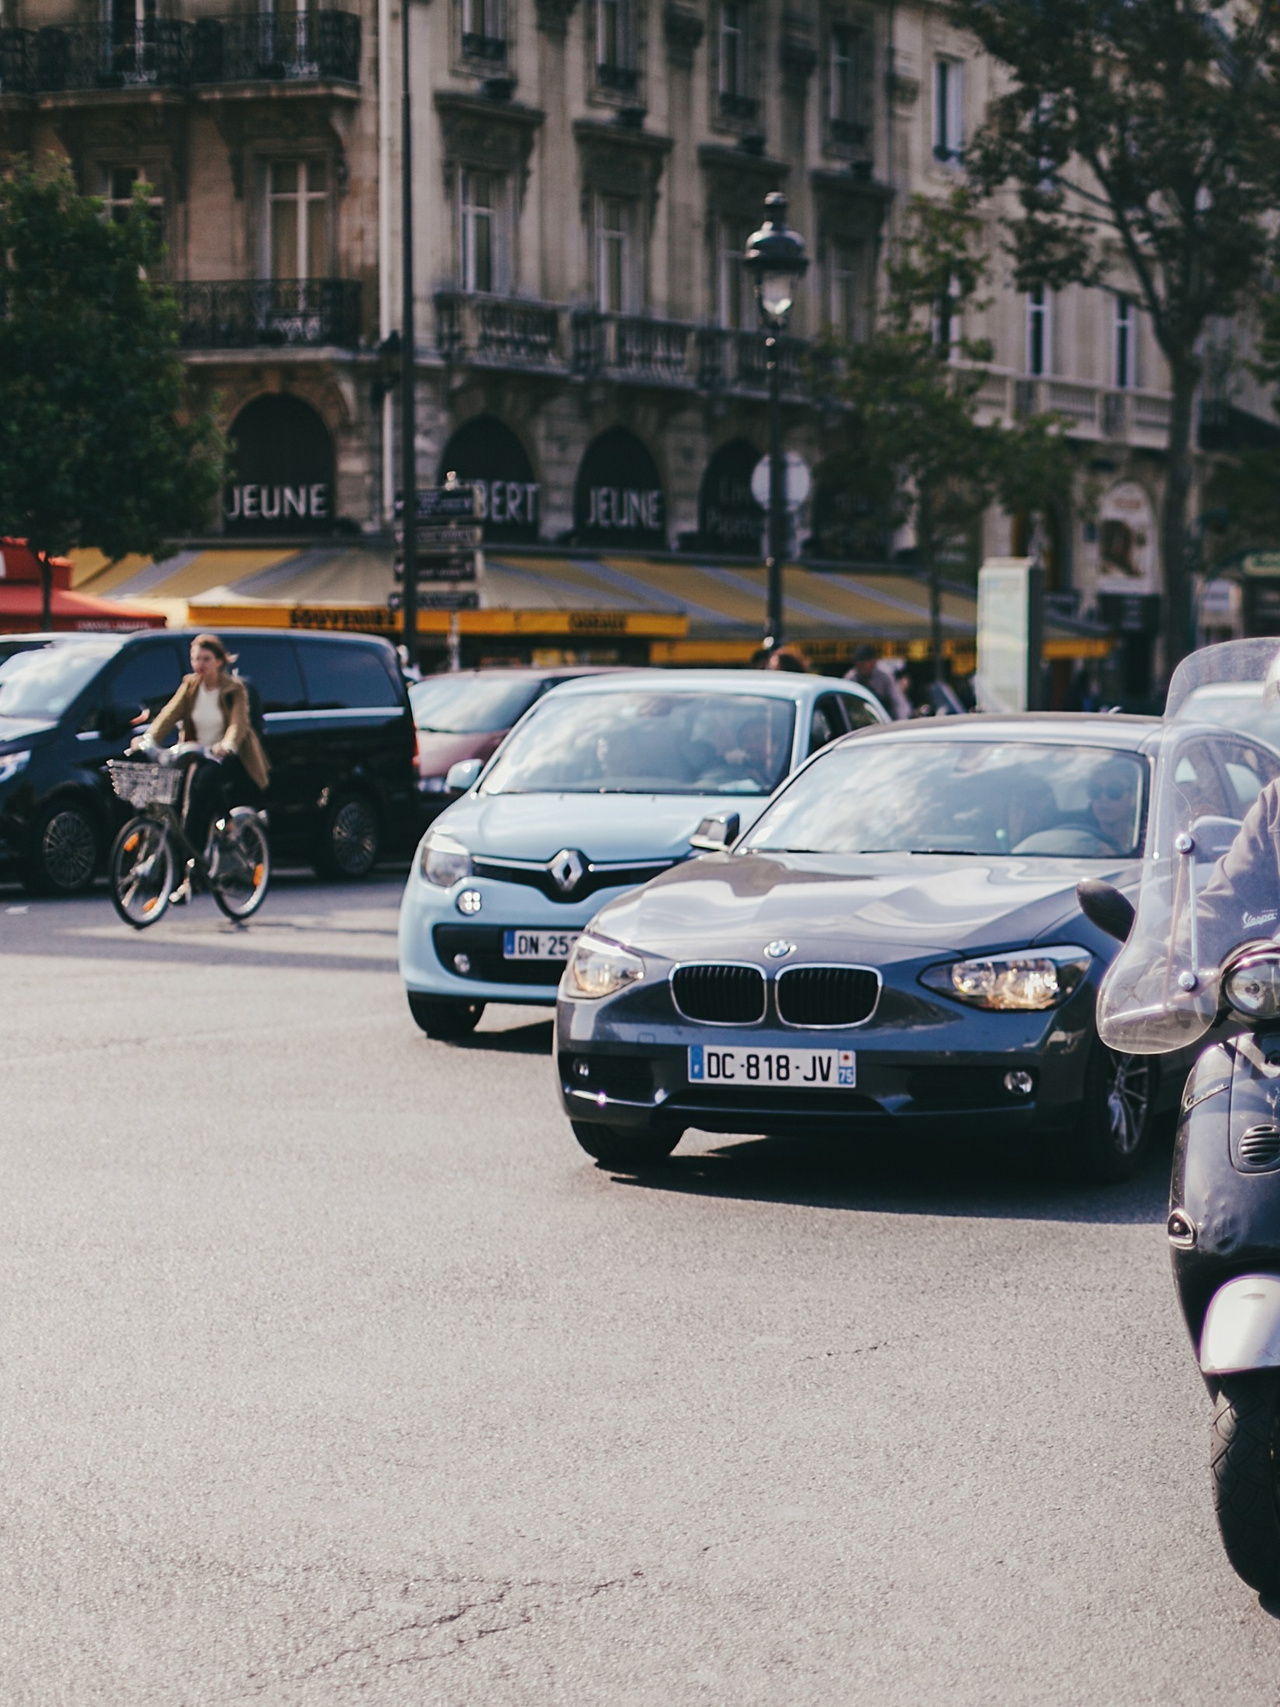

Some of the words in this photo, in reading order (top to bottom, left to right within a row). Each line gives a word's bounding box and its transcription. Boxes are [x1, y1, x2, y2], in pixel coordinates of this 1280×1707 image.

[226, 483, 327, 519] JEUNE
[587, 486, 660, 528] JEUNE
[518, 935, 577, 955] DN-25
[707, 1052, 832, 1082] DC-818-JV
